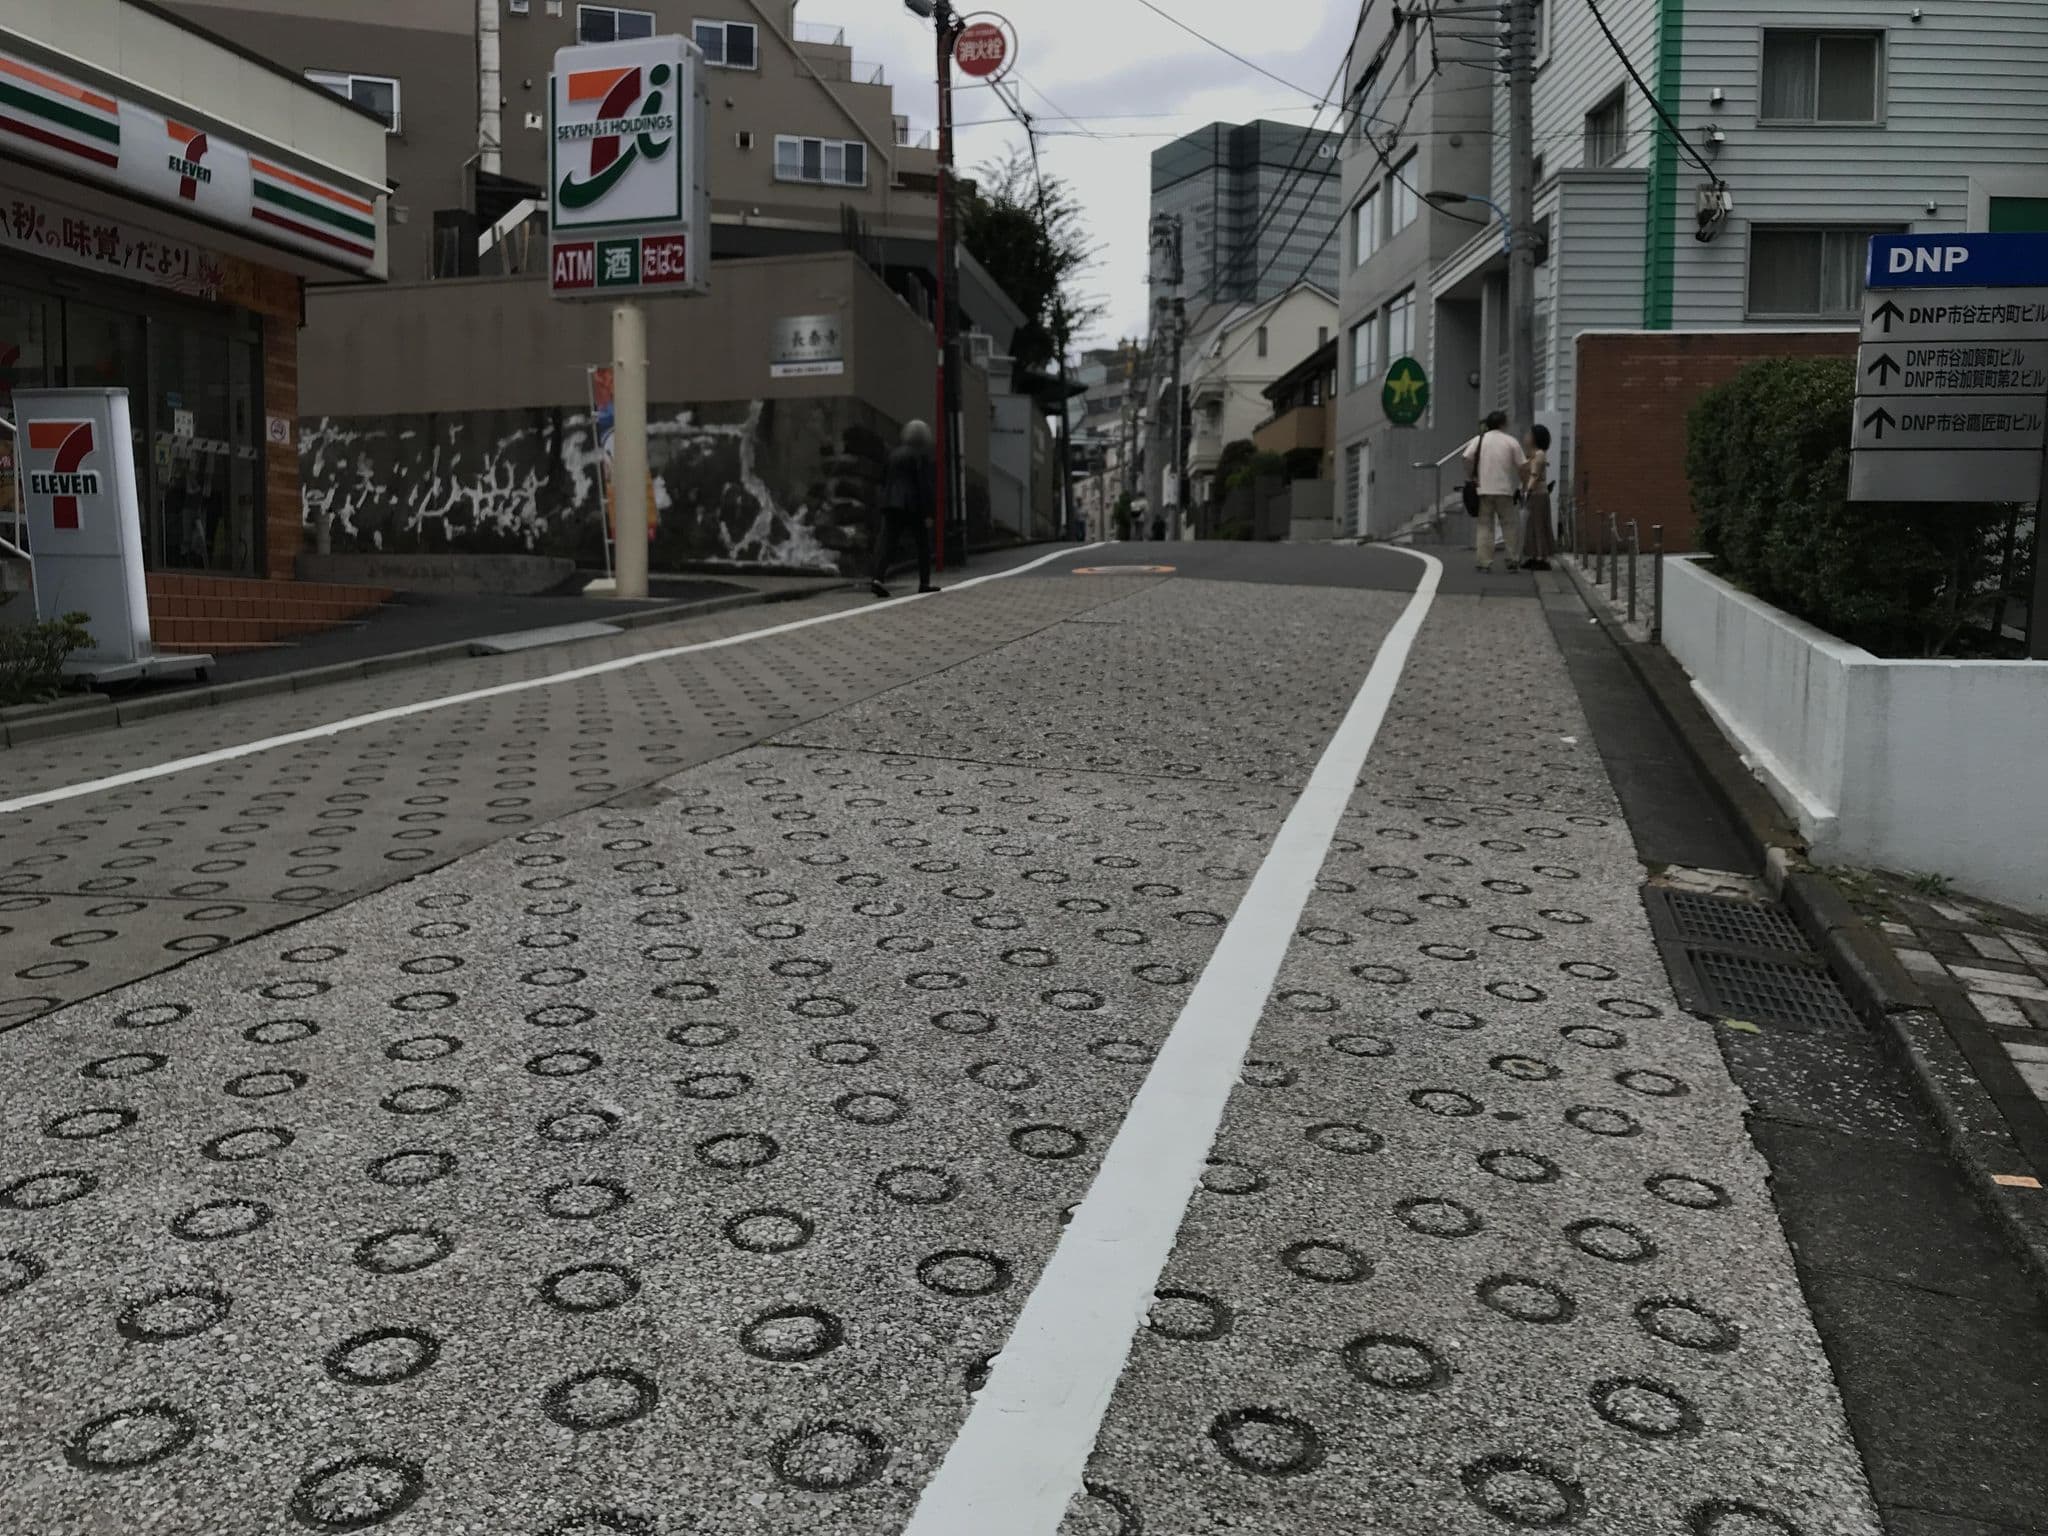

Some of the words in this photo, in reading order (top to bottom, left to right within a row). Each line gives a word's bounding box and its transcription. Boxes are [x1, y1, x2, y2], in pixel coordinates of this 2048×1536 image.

[611, 115, 673, 134] HOLDINGS
[555, 250, 593, 282] ATM
[605, 246, 632, 280] 酒
[643, 244, 684, 276] たばこ
[1888, 246, 1969, 273] DNP
